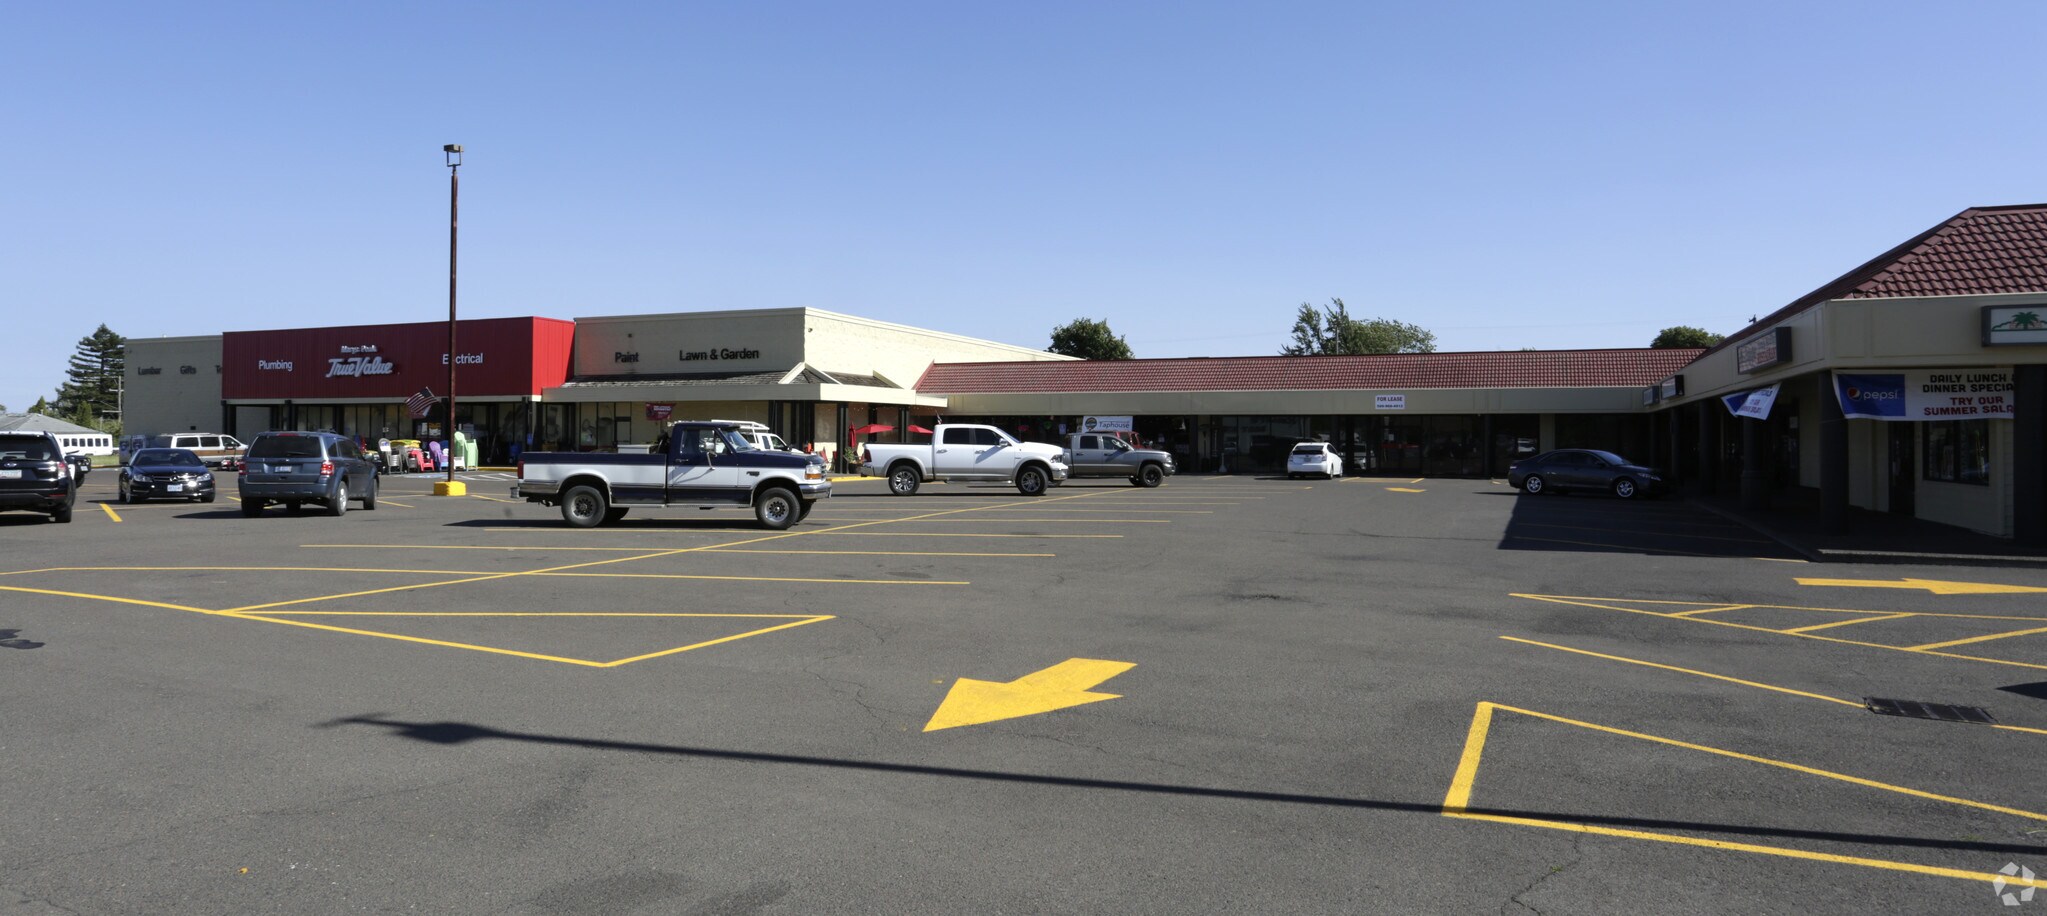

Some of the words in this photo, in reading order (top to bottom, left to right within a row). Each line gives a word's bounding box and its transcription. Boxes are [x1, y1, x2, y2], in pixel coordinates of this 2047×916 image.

[442, 353, 484, 365] Ectrical
[615, 352, 639, 363] Paint
[679, 349, 707, 361] Lawn
[710, 349, 718, 360] &
[720, 348, 759, 360] Garden
[258, 360, 293, 372] Plumbing
[1929, 374, 1962, 383] DAILY
[1967, 374, 2007, 383] LUNCH
[1922, 384, 1966, 393] DINNER
[1863, 389, 1898, 401] pepsi
[1950, 397, 1973, 406] TRY
[1978, 396, 2004, 405] OUR
[1923, 406, 1978, 416] SUMMER
[1099, 421, 1130, 429] Taphouse
